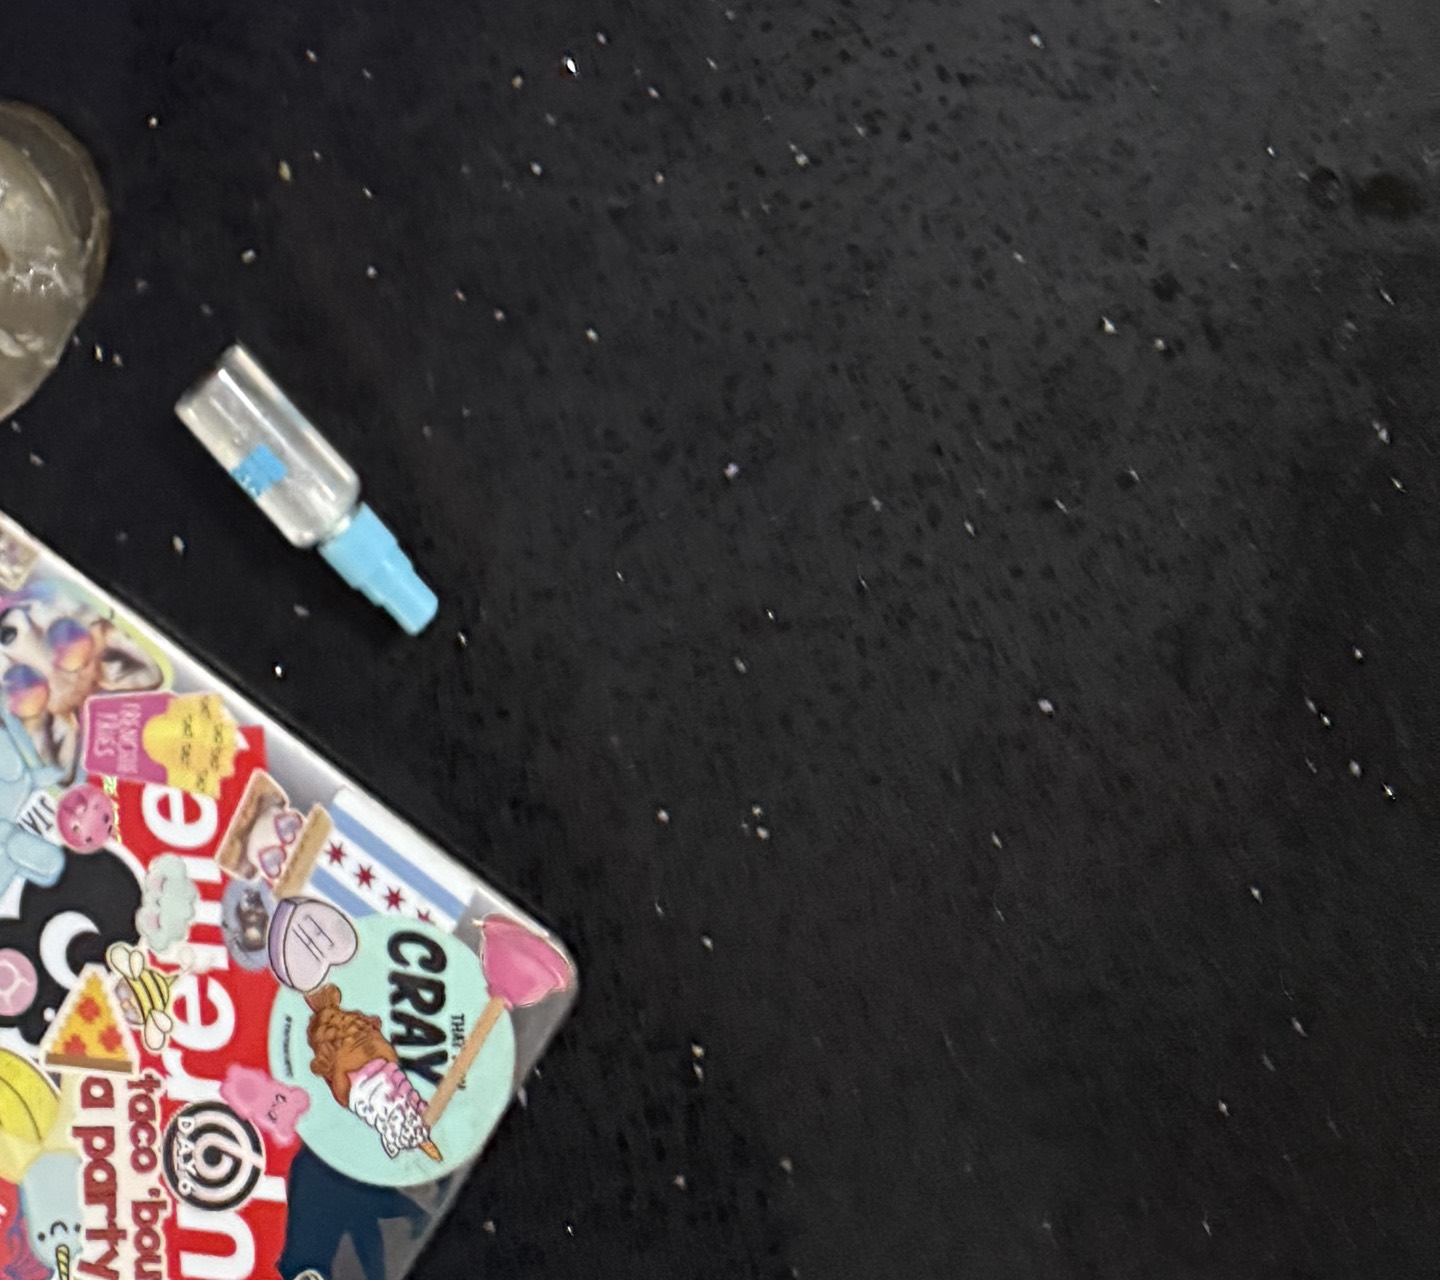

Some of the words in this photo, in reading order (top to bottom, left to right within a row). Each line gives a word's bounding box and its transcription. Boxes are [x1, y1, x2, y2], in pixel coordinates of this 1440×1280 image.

[387, 929, 448, 1086] CRAY
[80, 1076, 115, 1109] a
[127, 1073, 161, 1174] taco
[72, 1125, 128, 1280] party
